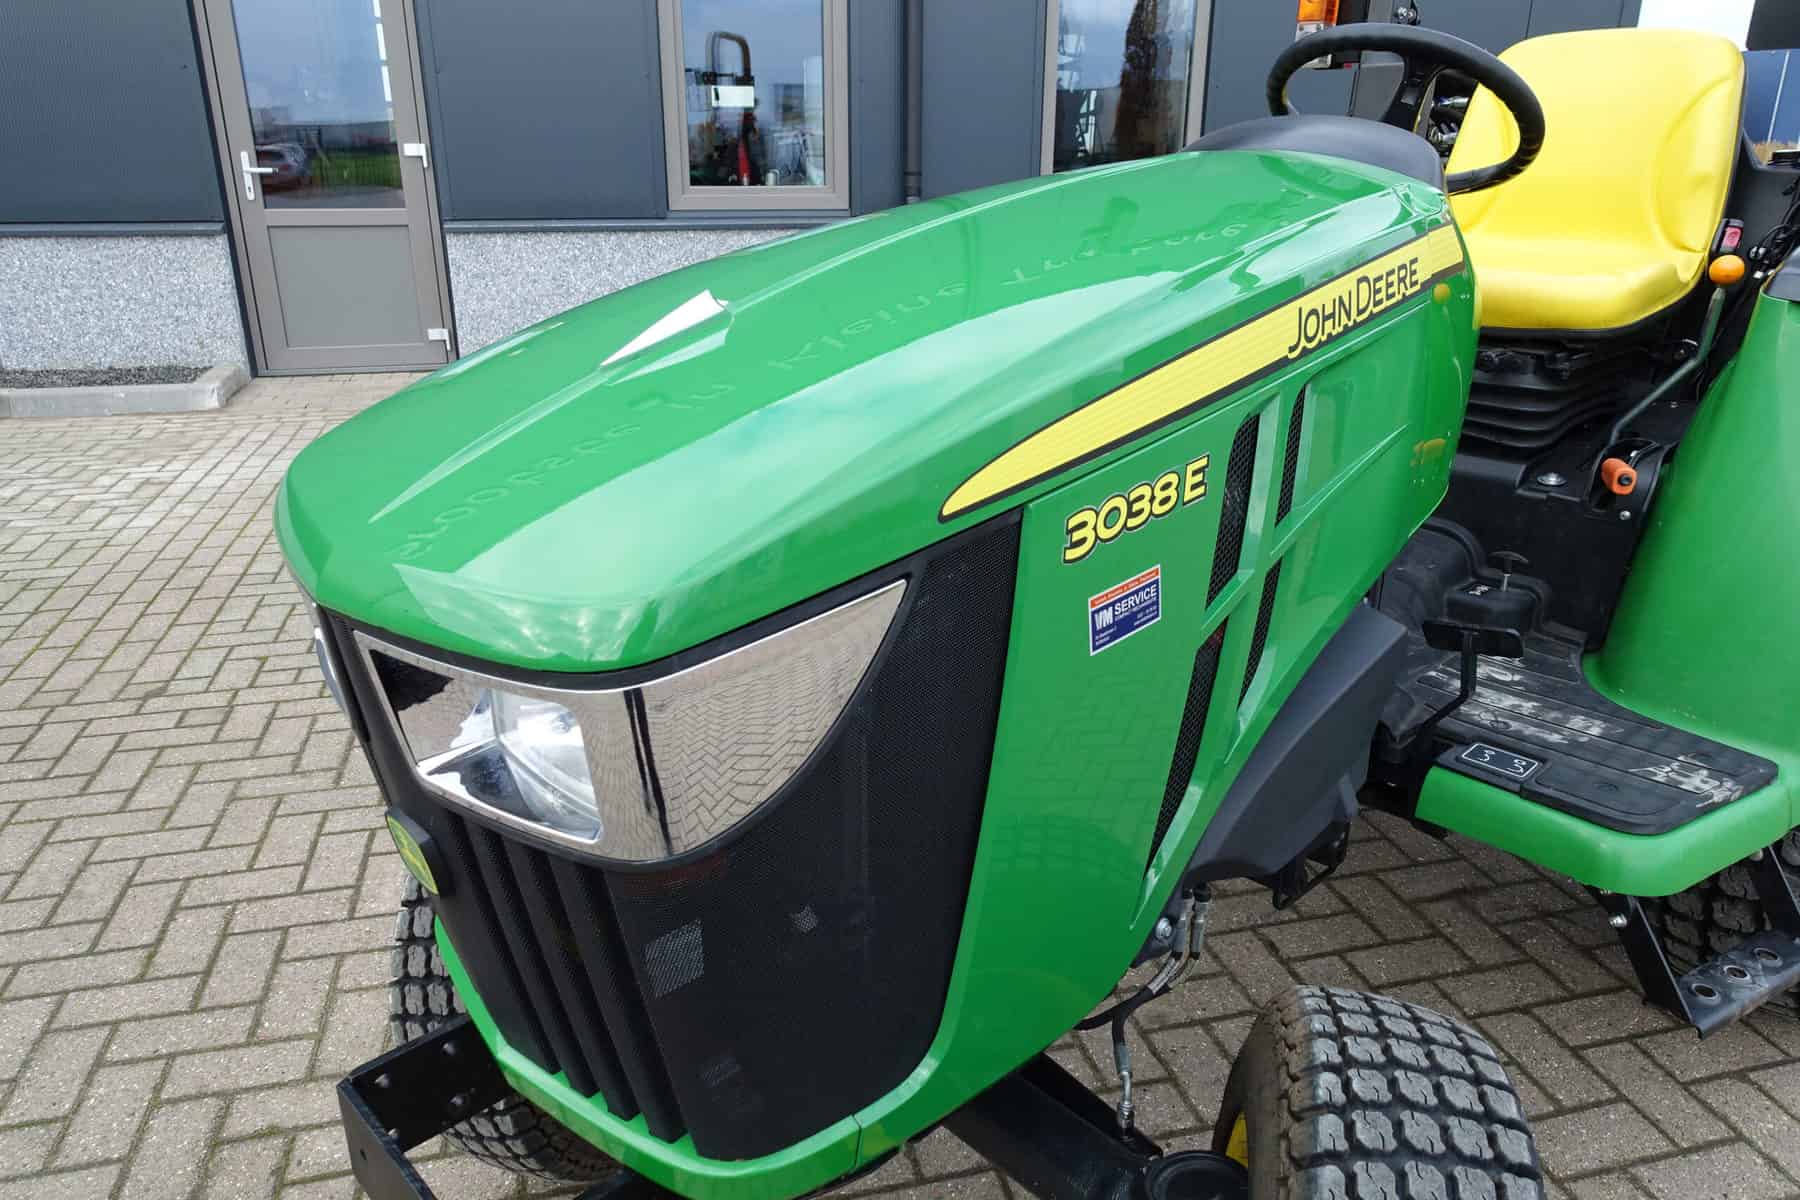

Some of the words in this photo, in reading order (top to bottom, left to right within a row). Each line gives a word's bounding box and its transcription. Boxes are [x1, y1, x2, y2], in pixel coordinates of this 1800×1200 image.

[1288, 289, 1352, 354] JOHN
[1356, 257, 1419, 317] DEERE
[1114, 584, 1157, 616] SERVICE
